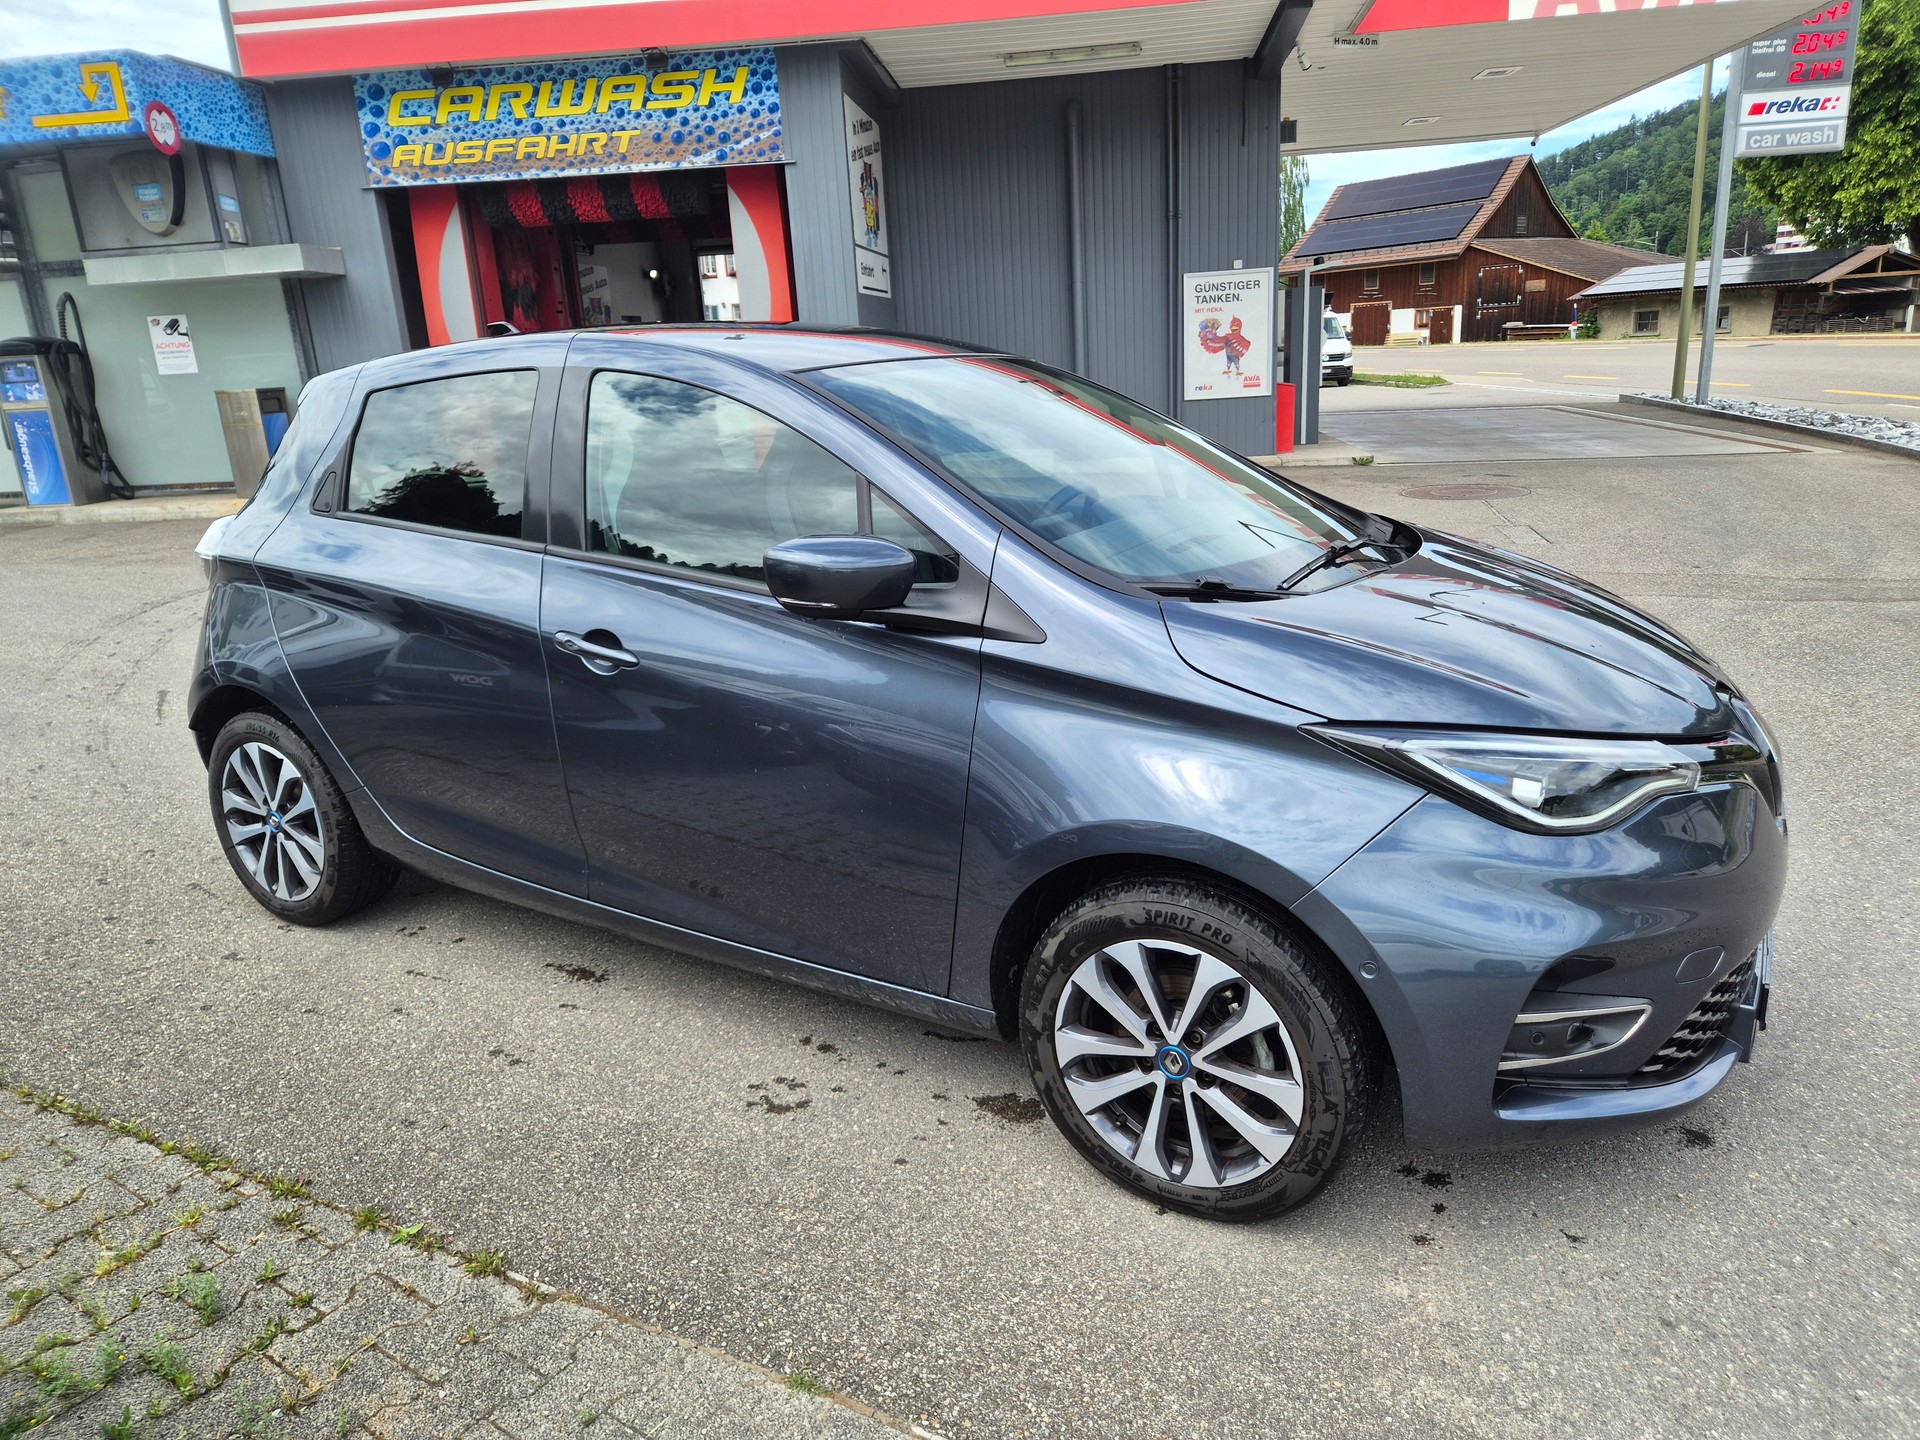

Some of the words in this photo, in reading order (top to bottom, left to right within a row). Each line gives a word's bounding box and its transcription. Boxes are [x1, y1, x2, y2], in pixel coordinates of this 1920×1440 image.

[1334, 37, 1340, 45] H
[1772, 38, 1787, 46] plus
[1751, 46, 1775, 54] bleifrei
[1776, 45, 1786, 53] 98
[1756, 70, 1776, 78] diesel
[387, 66, 749, 127] CARWASH
[1749, 134, 1780, 148] car
[1785, 127, 1835, 146] wash
[391, 129, 642, 169] AUSFAHRT
[860, 262, 875, 279] Einfahrt
[1194, 280, 1261, 294] GÜNSTIGER
[1194, 293, 1243, 305] TANKEN.
[156, 341, 191, 350] ACHTUNG
[1243, 375, 1261, 383] AVIA
[1194, 383, 1213, 392] reka
[14, 421, 40, 495] Staubsauger
[1144, 908, 1196, 930] SPIRIT
[1200, 922, 1233, 945] PRO
